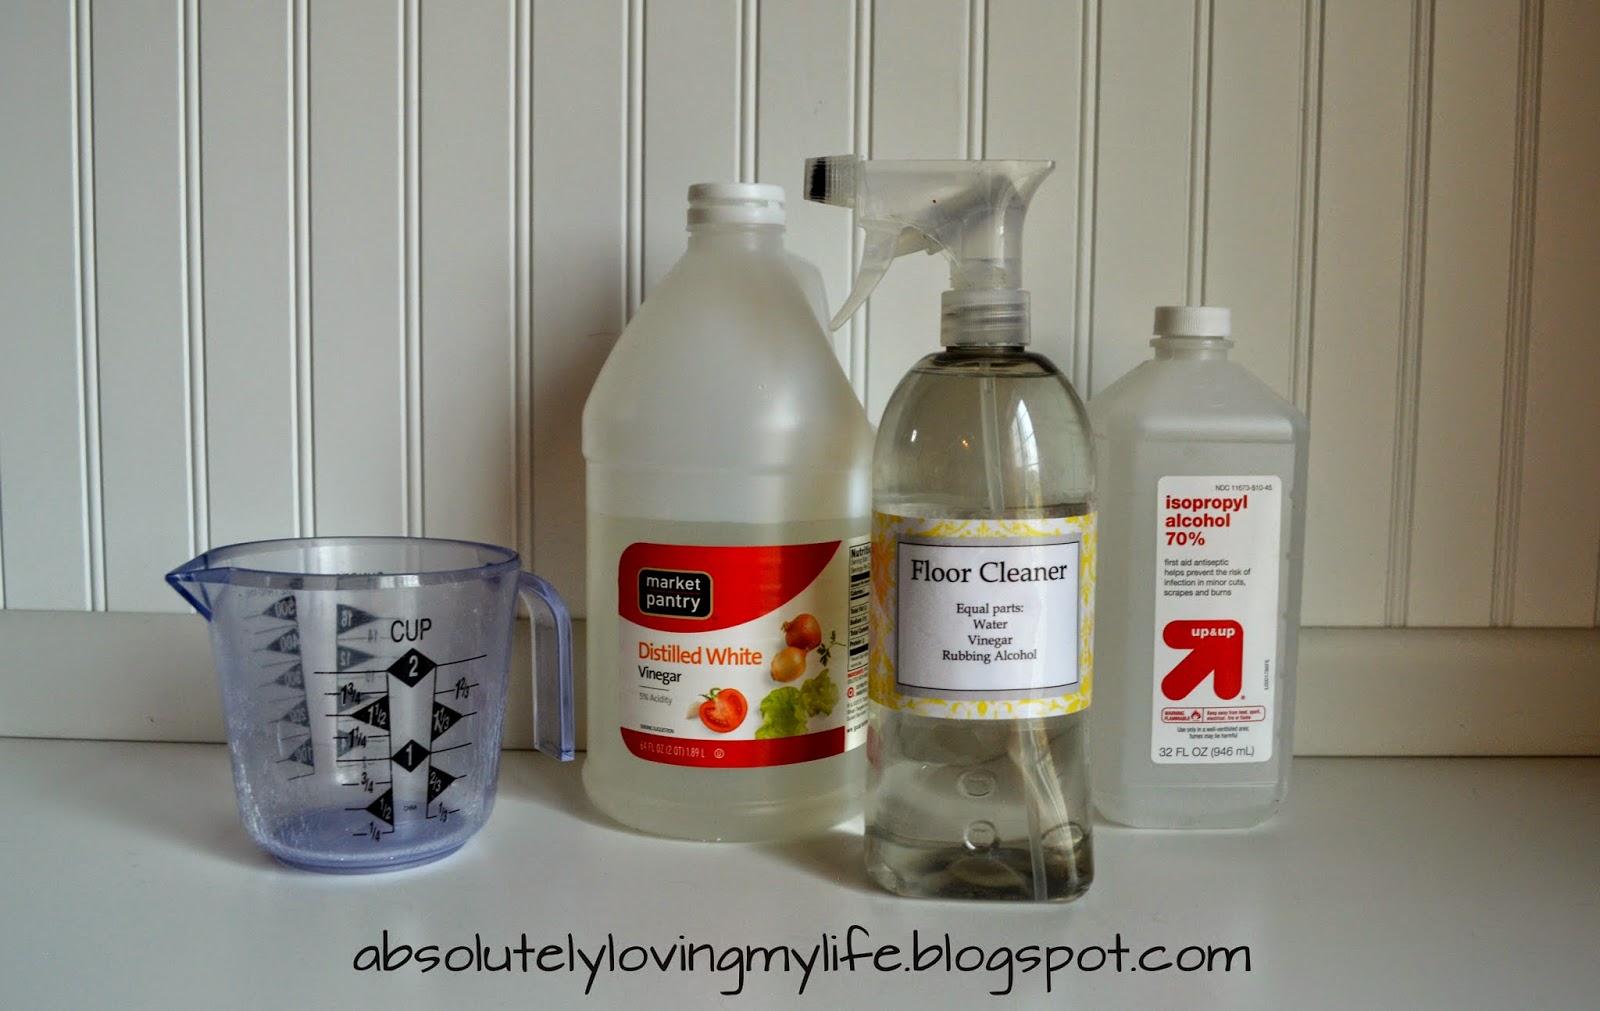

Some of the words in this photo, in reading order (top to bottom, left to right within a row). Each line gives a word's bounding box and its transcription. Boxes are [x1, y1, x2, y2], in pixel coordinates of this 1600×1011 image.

[1165, 495, 1248, 512] isopropyl
[1165, 513, 1231, 527] alcohol
[1165, 531, 1206, 546] 70%
[1180, 558, 1192, 566] aid
[1193, 558, 1229, 567] antiseptic
[911, 559, 972, 583] Floor
[979, 561, 1068, 583] Cleaner
[1164, 569, 1185, 577] helps
[1186, 569, 1214, 577] prevent
[1215, 568, 1228, 576] the
[1228, 568, 1242, 576] risk
[1243, 568, 1251, 576] of
[646, 576, 701, 591] market
[1164, 579, 1196, 587] infection
[1228, 579, 1246, 587] cuts,
[1164, 589, 1194, 597] scrapes
[646, 593, 701, 613] pantry
[956, 603, 989, 617] Equal
[992, 603, 1024, 617] parts:
[390, 618, 432, 643] CUP
[973, 619, 1008, 630] Water
[1191, 627, 1236, 639] up&up
[968, 635, 1013, 648] Vinegar
[638, 641, 702, 665] Distilled
[706, 647, 762, 666] White
[942, 650, 991, 664] Rubbing
[994, 649, 1037, 661] Alcohol
[409, 655, 419, 677] 2
[638, 665, 682, 685] Vinegar
[640, 692, 649, 701] 5%
[650, 694, 673, 706] Acidity
[405, 745, 413, 766] 1
[640, 741, 647, 750] 64
[648, 742, 655, 753] FL
[656, 743, 664, 754] OZ
[665, 745, 672, 755] (2
[673, 745, 685, 757] QT)
[686, 747, 700, 757] 1.89
[701, 748, 705, 758] L
[1159, 747, 1173, 757] 32
[1175, 747, 1189, 757] FL
[1191, 747, 1209, 757] OZ
[1210, 746, 1233, 759] (946
[1235, 746, 1255, 758] mL)
